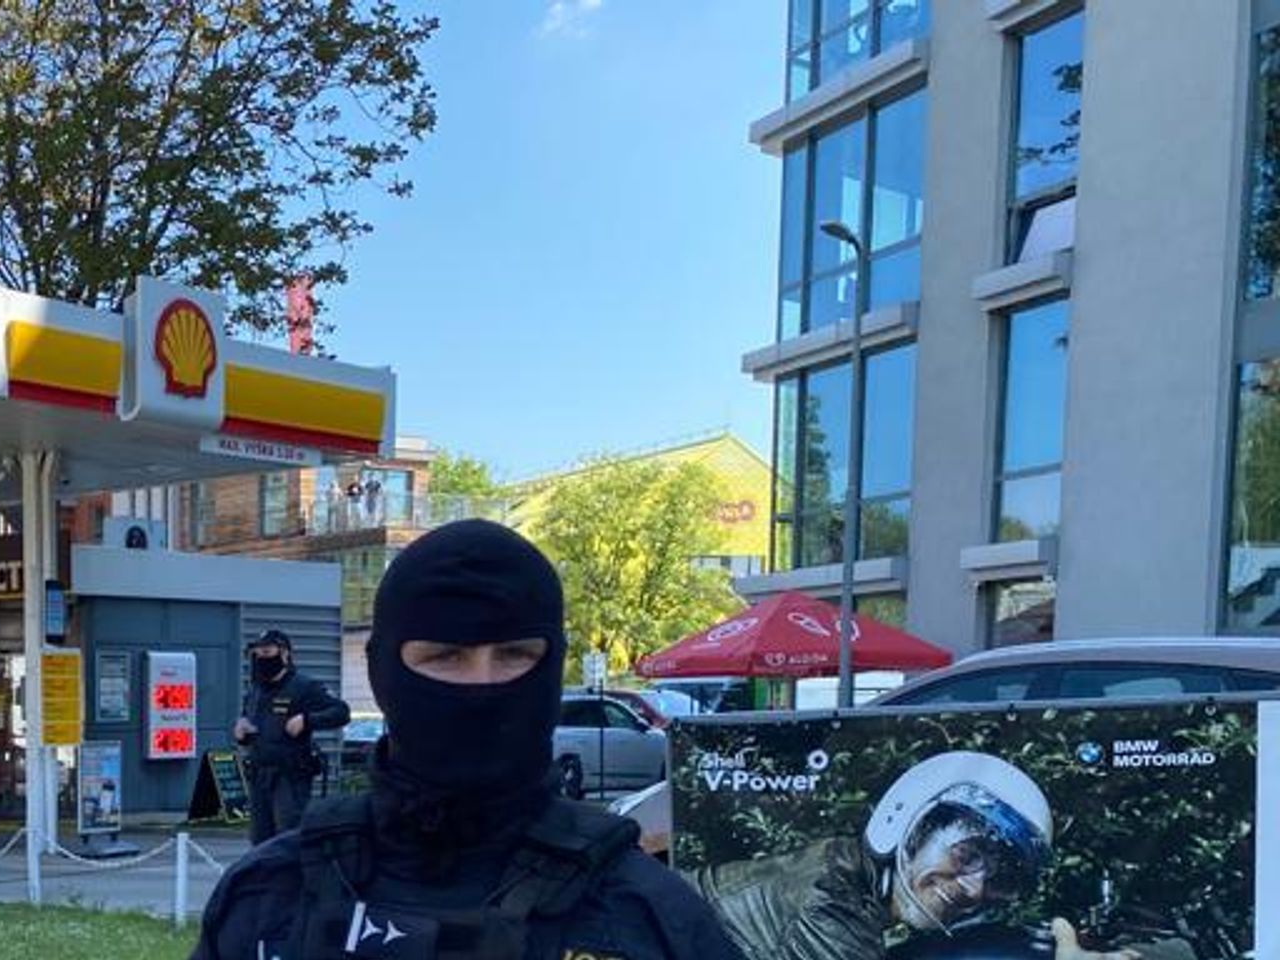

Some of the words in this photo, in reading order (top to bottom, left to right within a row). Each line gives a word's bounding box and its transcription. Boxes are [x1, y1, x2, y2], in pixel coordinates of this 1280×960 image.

[1113, 740, 1159, 753] BMW
[1113, 752, 1217, 767] MOTORRAD
[704, 769, 820, 791] V-Power
